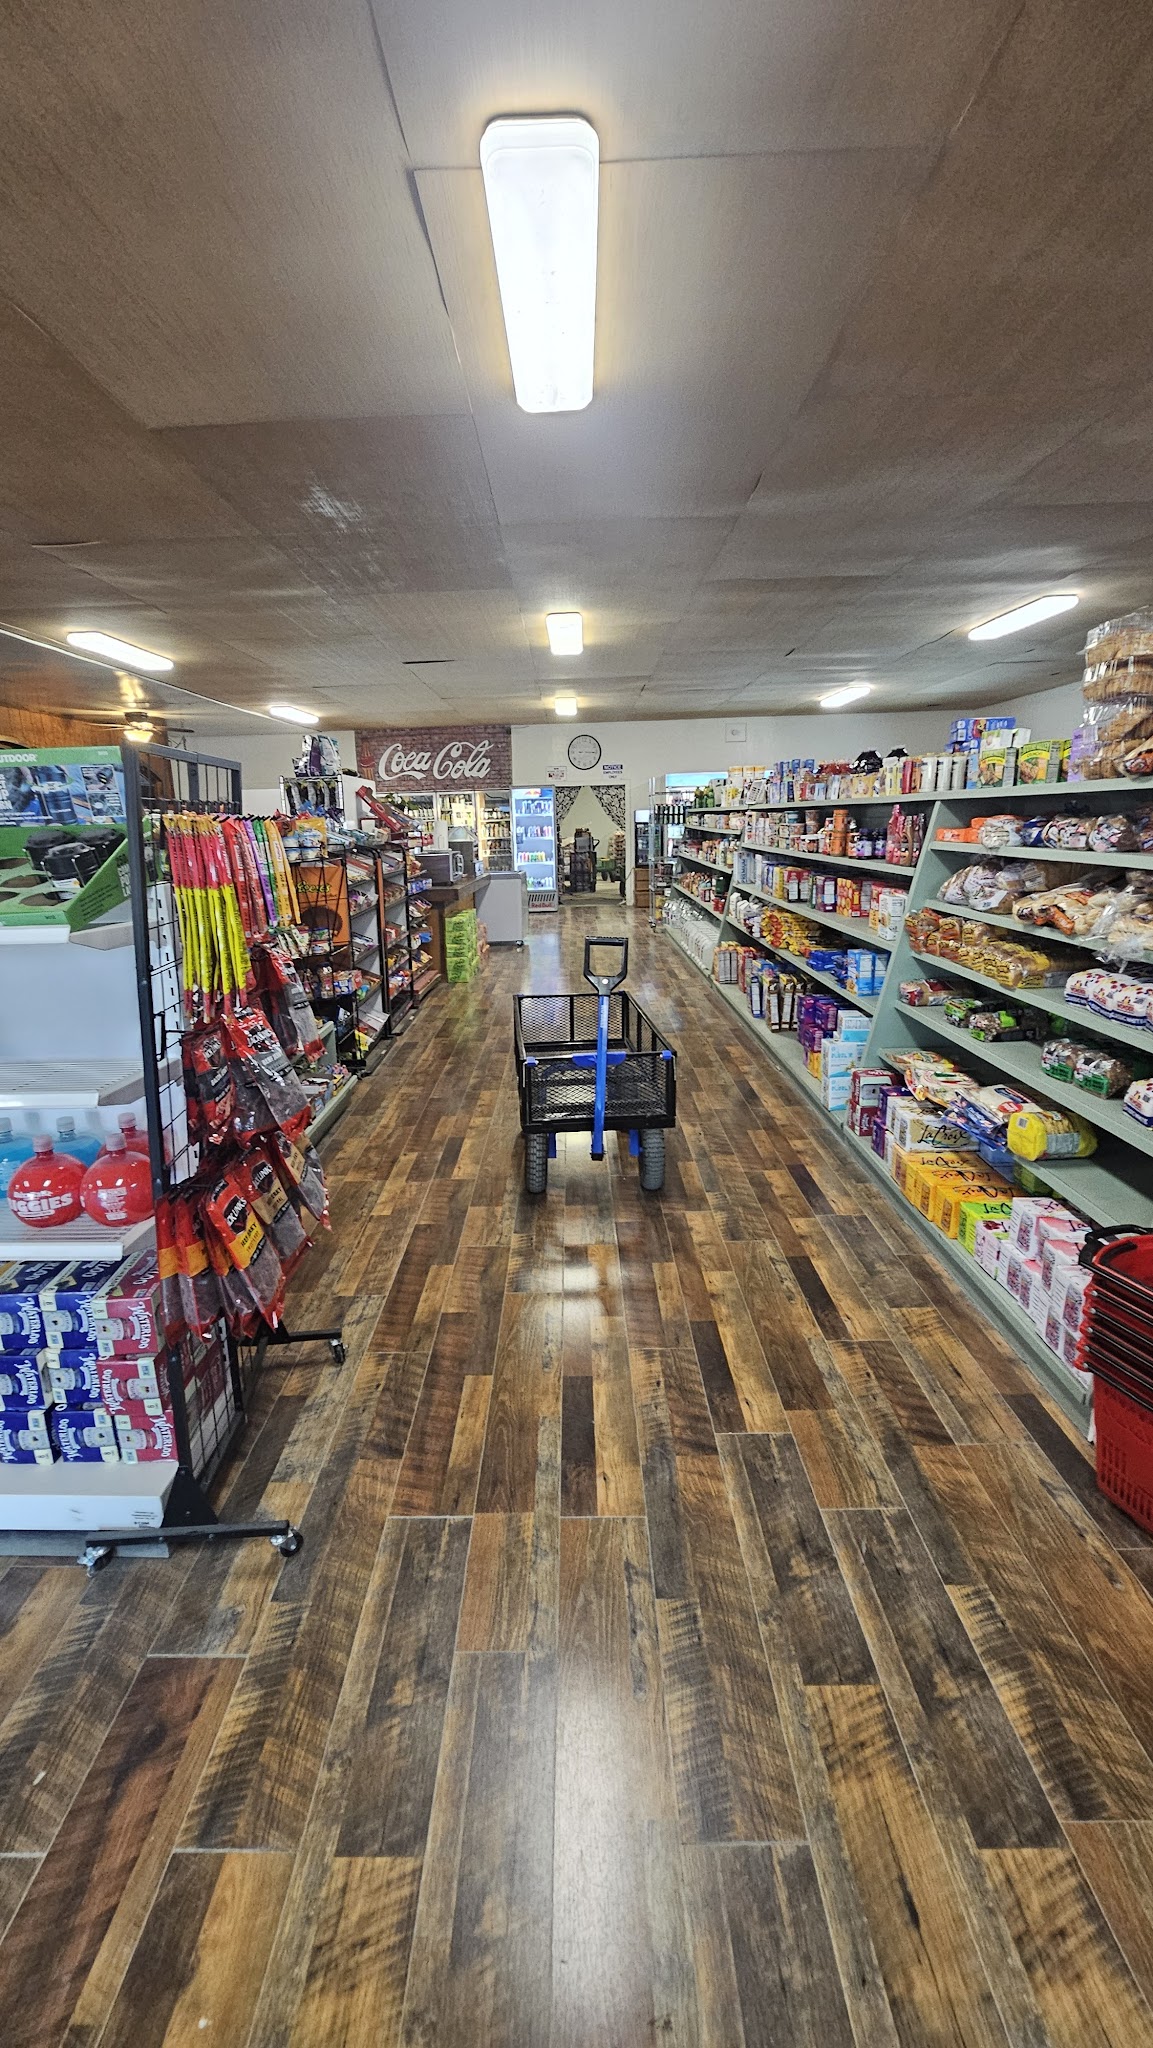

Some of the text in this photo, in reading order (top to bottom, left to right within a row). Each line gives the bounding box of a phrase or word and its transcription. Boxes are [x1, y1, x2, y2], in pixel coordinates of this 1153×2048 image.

[379, 740, 494, 780] Coca Cola
[16, 1297, 41, 1344] WATERLOO
[128, 1301, 152, 1349] WATERLOO
[14, 1360, 39, 1405] WATERLOO
[149, 1413, 175, 1458] WATERLOO
